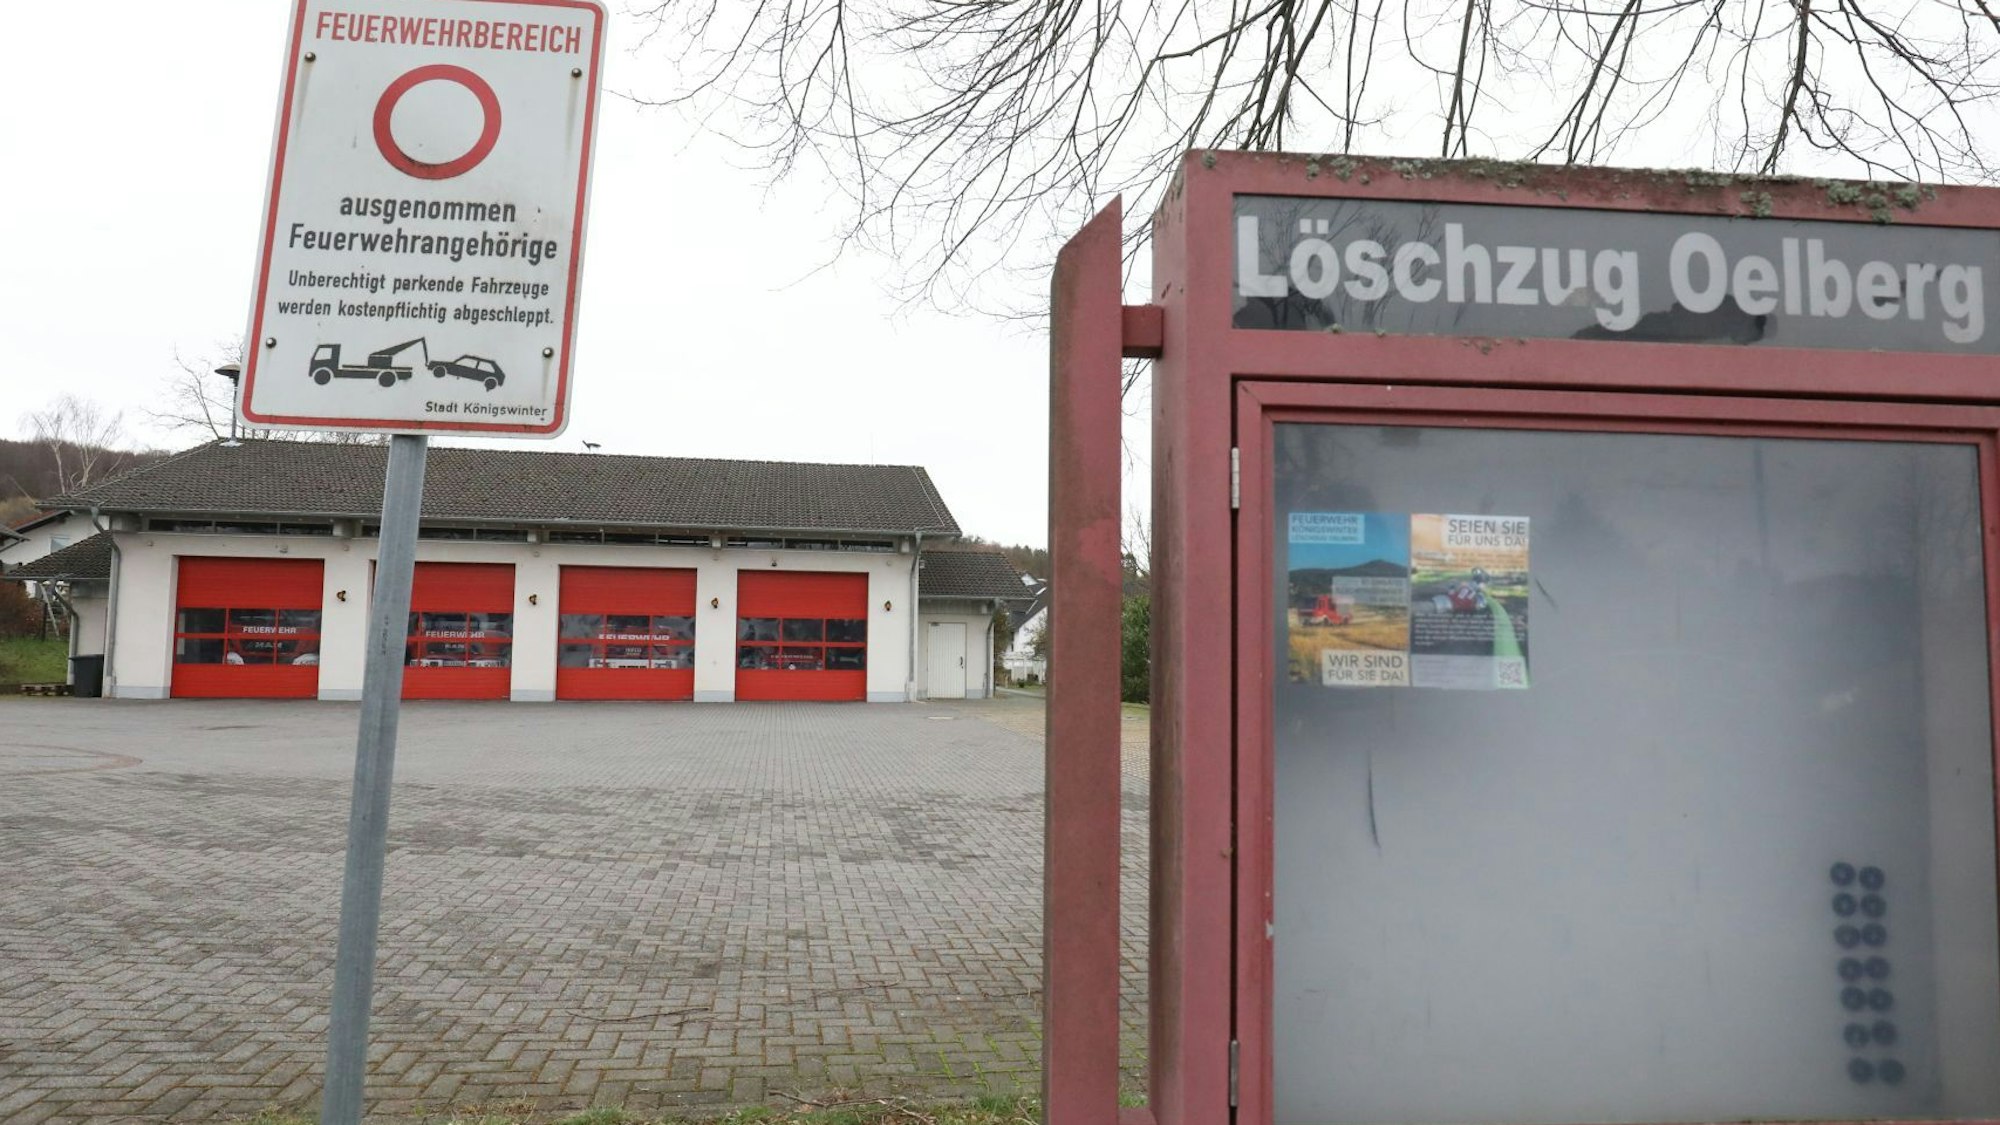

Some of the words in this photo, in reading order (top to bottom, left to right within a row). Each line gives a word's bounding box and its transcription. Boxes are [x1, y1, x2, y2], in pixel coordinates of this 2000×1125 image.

[315, 11, 582, 54] FEUERWEHRBEREICH
[340, 196, 516, 224] ausgenommen
[288, 223, 558, 265] Feuerwehrangehörige
[288, 270, 386, 294] Unberechtigt
[392, 273, 464, 294] parkende
[471, 276, 549, 299] Fahrzeuge
[1236, 215, 1640, 332] Löschzug
[1668, 232, 1985, 344] Oelberg
[278, 298, 331, 316] werden
[338, 298, 447, 323] kostenpflichtig
[454, 303, 554, 327] abgeschleppt.
[425, 401, 459, 415] Stadt
[463, 401, 548, 419] Königswinter
[1448, 519, 1496, 534] SEIEN
[1501, 520, 1526, 535] SIE
[1475, 535, 1500, 547] UNS
[1328, 654, 1359, 668] WIR
[1364, 655, 1403, 669] SIND
[1358, 670, 1376, 681] SIE
